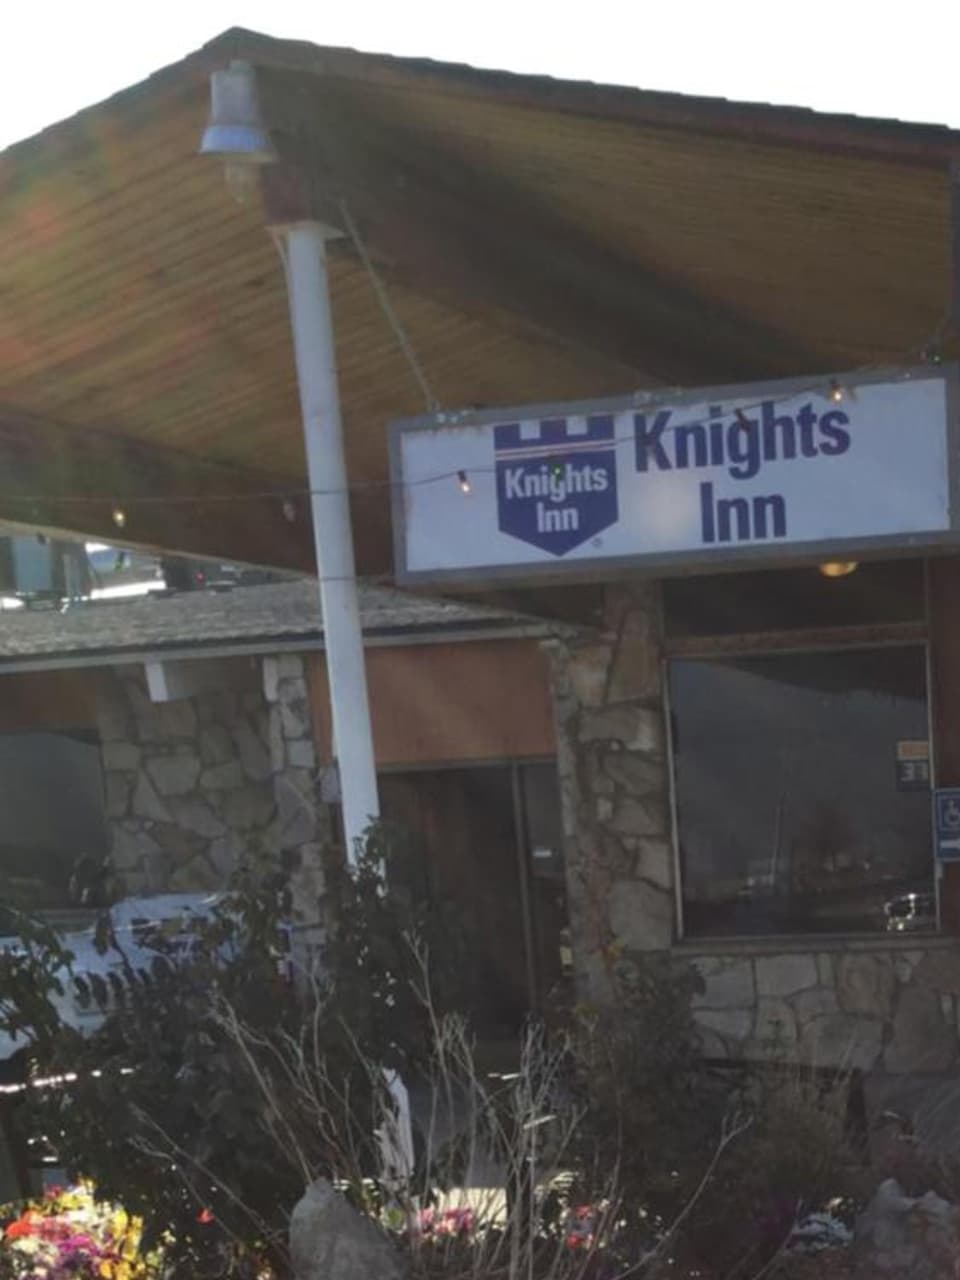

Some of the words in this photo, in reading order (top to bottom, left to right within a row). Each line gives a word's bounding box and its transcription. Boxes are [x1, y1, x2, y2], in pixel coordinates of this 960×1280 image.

[634, 400, 851, 480] Knights
[504, 463, 609, 502] Knights
[536, 501, 579, 532] Inn
[699, 482, 787, 543] Inn
